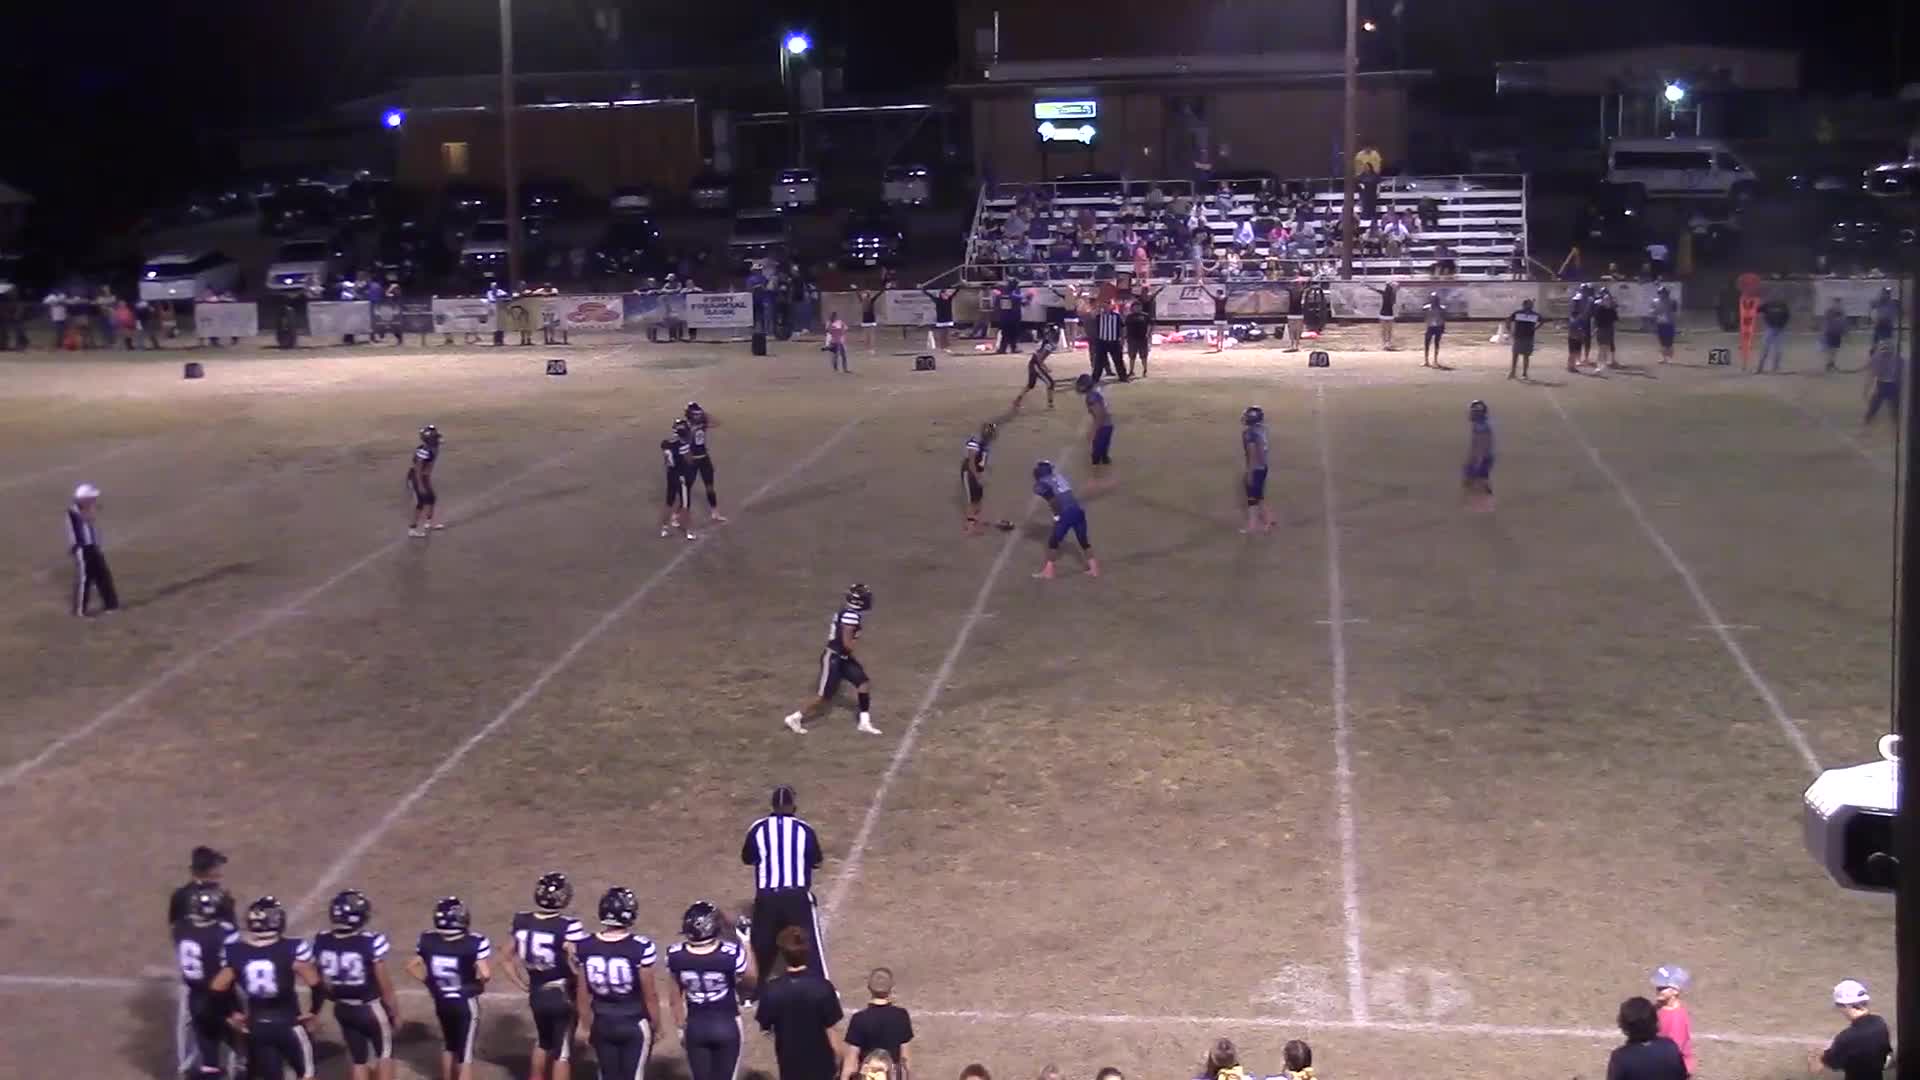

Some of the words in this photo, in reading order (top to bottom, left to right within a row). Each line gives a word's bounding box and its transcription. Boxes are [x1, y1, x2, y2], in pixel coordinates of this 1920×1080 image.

[514, 930, 555, 972] 15
[244, 959, 278, 999] 8
[431, 955, 461, 998] 5
[592, 955, 633, 995] 60
